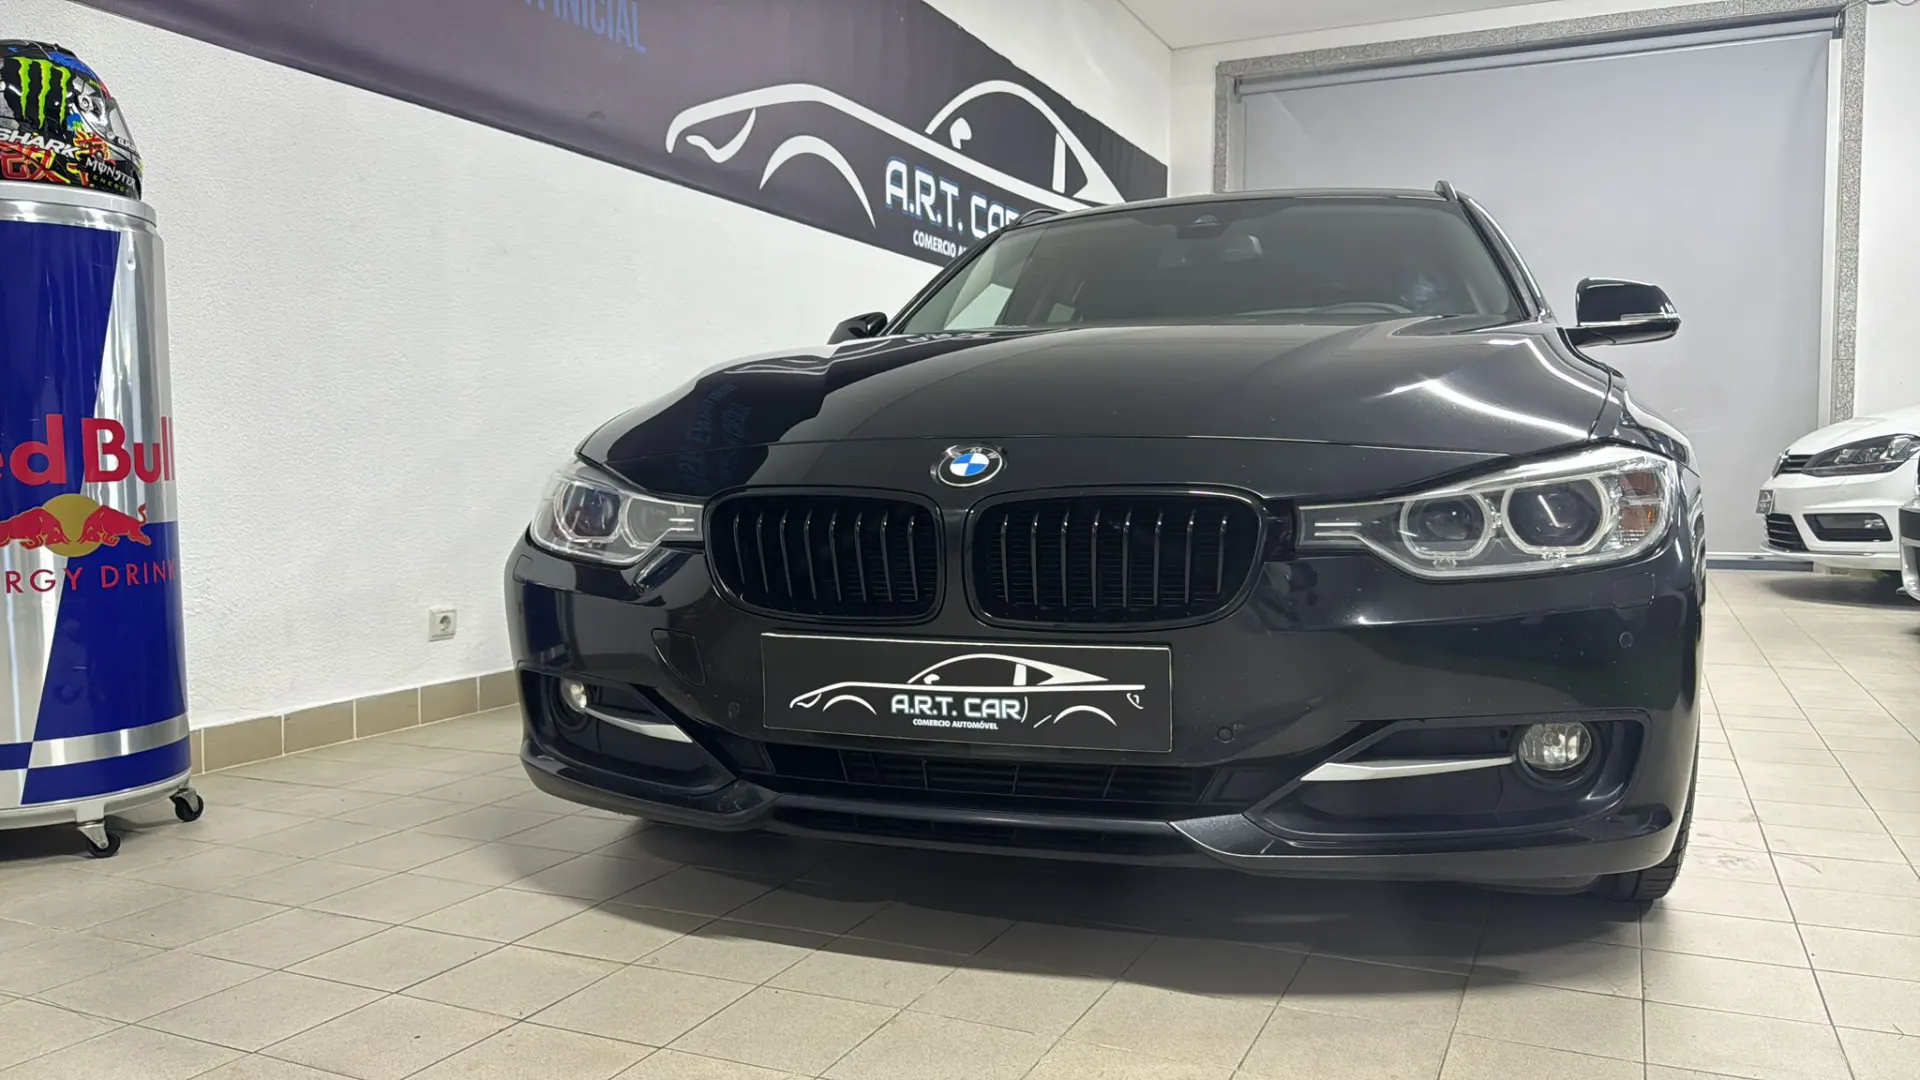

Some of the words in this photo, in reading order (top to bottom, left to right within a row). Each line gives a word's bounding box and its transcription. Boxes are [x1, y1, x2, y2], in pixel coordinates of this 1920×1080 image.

[0, 128, 79, 159] SHARK
[86, 155, 135, 190] MONSTER
[885, 156, 964, 234] A.R.T.
[913, 229, 957, 258] COMERCIO
[82, 416, 175, 484] Bull
[101, 559, 176, 591] DRINK
[891, 694, 958, 717] A.R.T.
[912, 718, 950, 728] COMERCIO
[952, 719, 999, 730] AUTOMÓVEL
